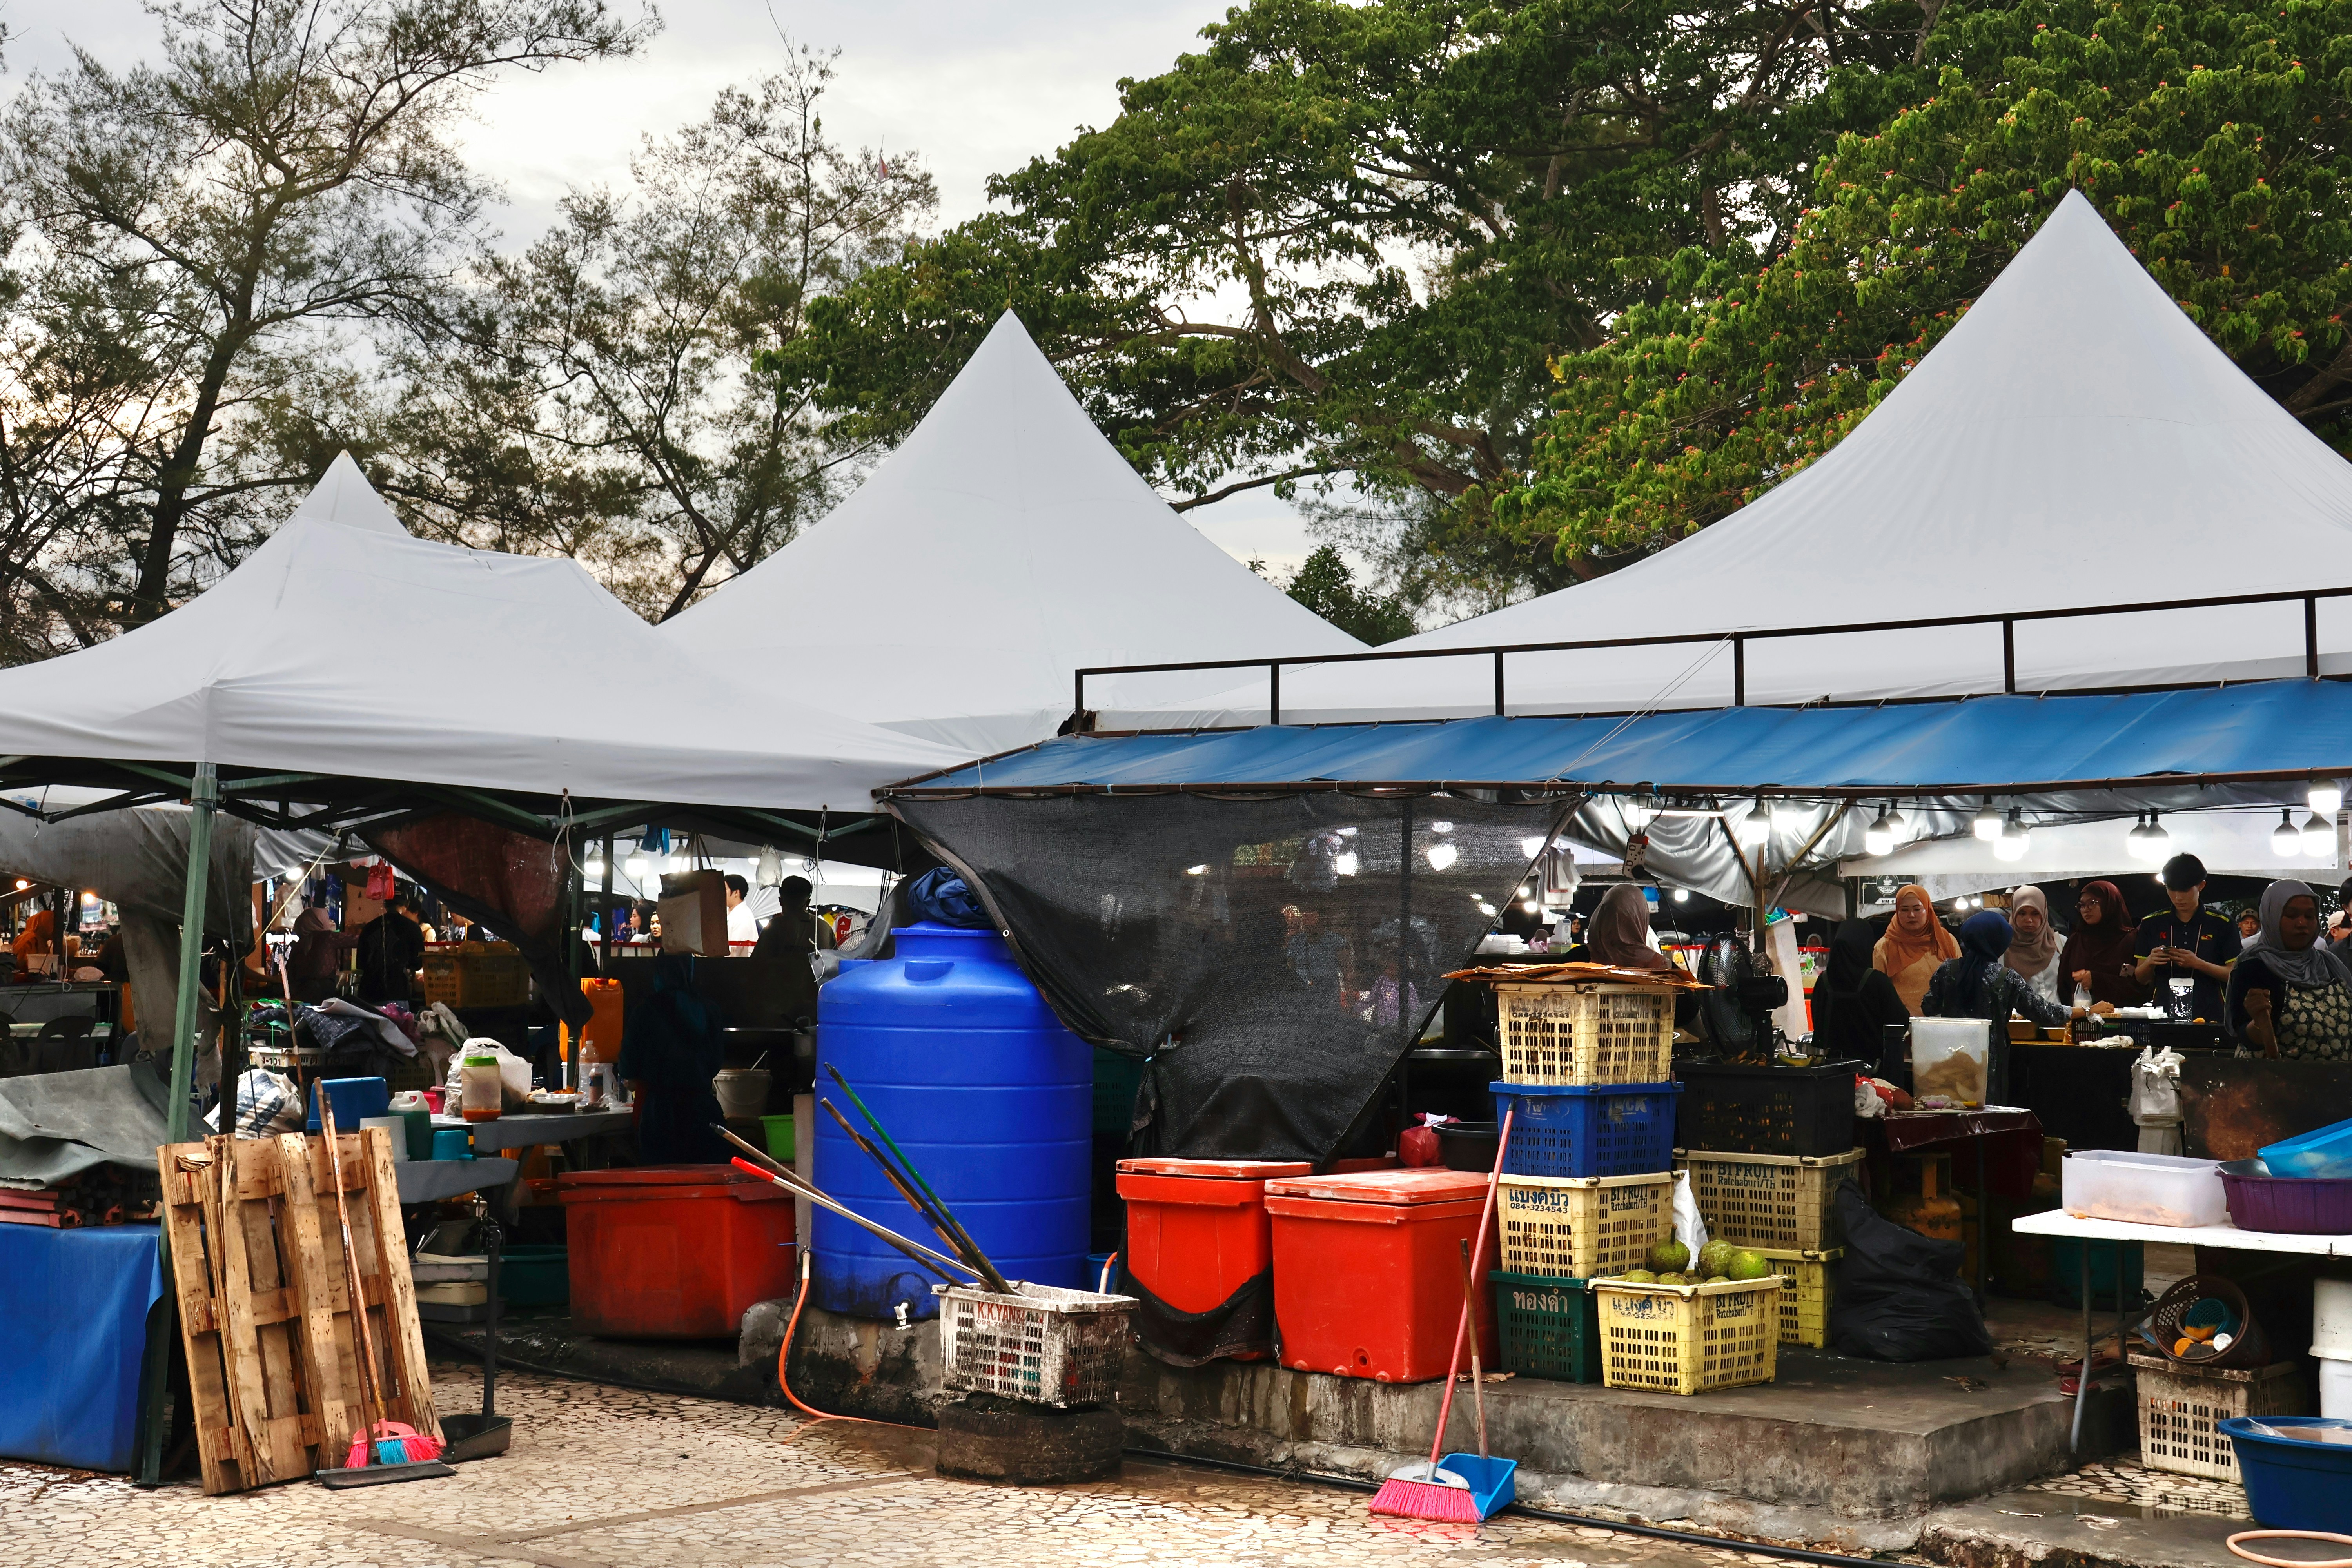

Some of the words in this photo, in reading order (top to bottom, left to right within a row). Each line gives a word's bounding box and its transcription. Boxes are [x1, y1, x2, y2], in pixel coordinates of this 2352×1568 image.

[1718, 1162, 1732, 1175] BI
[1735, 1163, 1776, 1178] FRUIT
[1718, 1176, 1775, 1189] Ratchaburi/TH
[1611, 1187, 1620, 1201] BI
[1622, 1184, 1648, 1200] FRUIT
[1510, 1202, 1568, 1214] 084-3234543
[1611, 1198, 1647, 1211] Ratchaburi/TH
[1513, 1288, 1568, 1314] ทองคำ
[1716, 1294, 1725, 1308] BI
[1728, 1290, 1756, 1307] FRUIT
